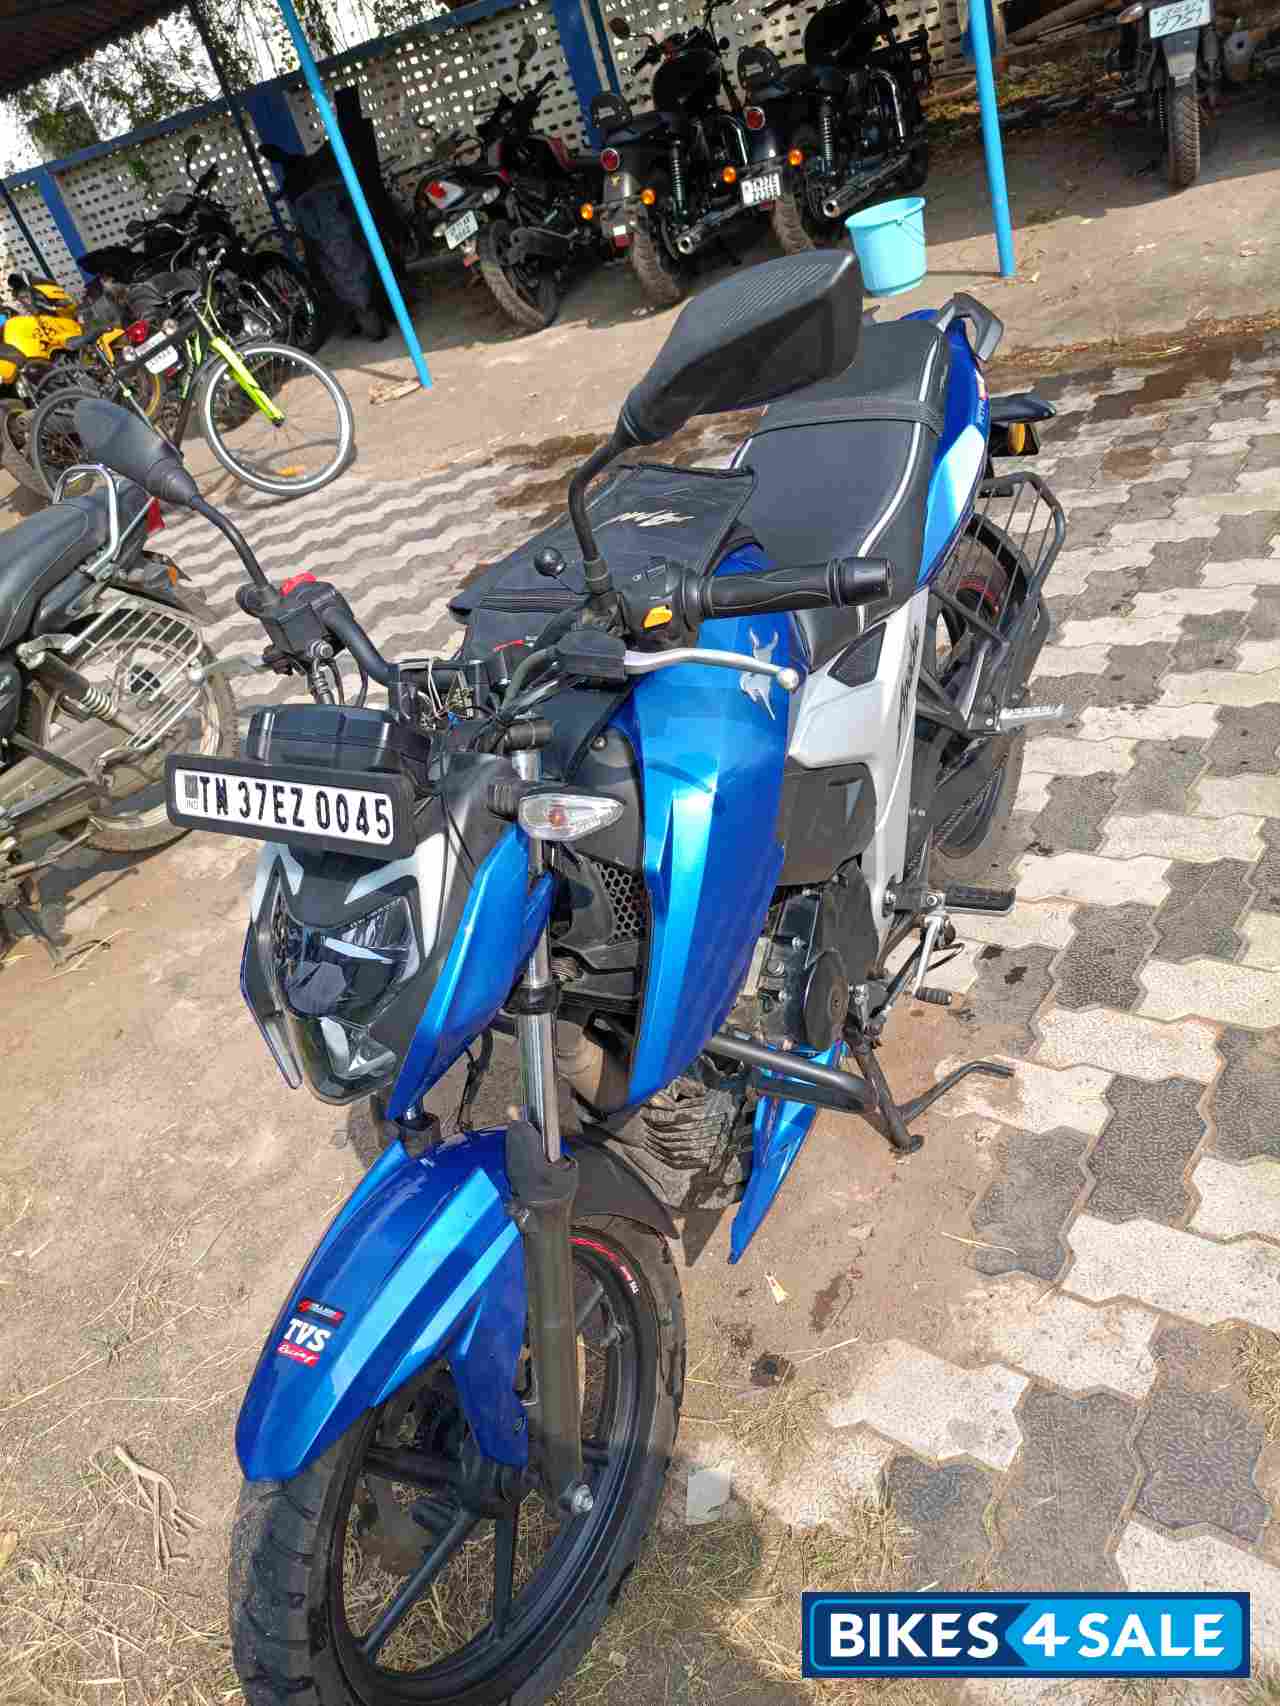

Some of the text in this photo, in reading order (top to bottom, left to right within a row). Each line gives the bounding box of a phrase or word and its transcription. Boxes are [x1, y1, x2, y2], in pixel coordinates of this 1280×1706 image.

[200, 775, 229, 816] TN
[315, 790, 390, 838] 0045
[284, 1318, 331, 1351] TVS
